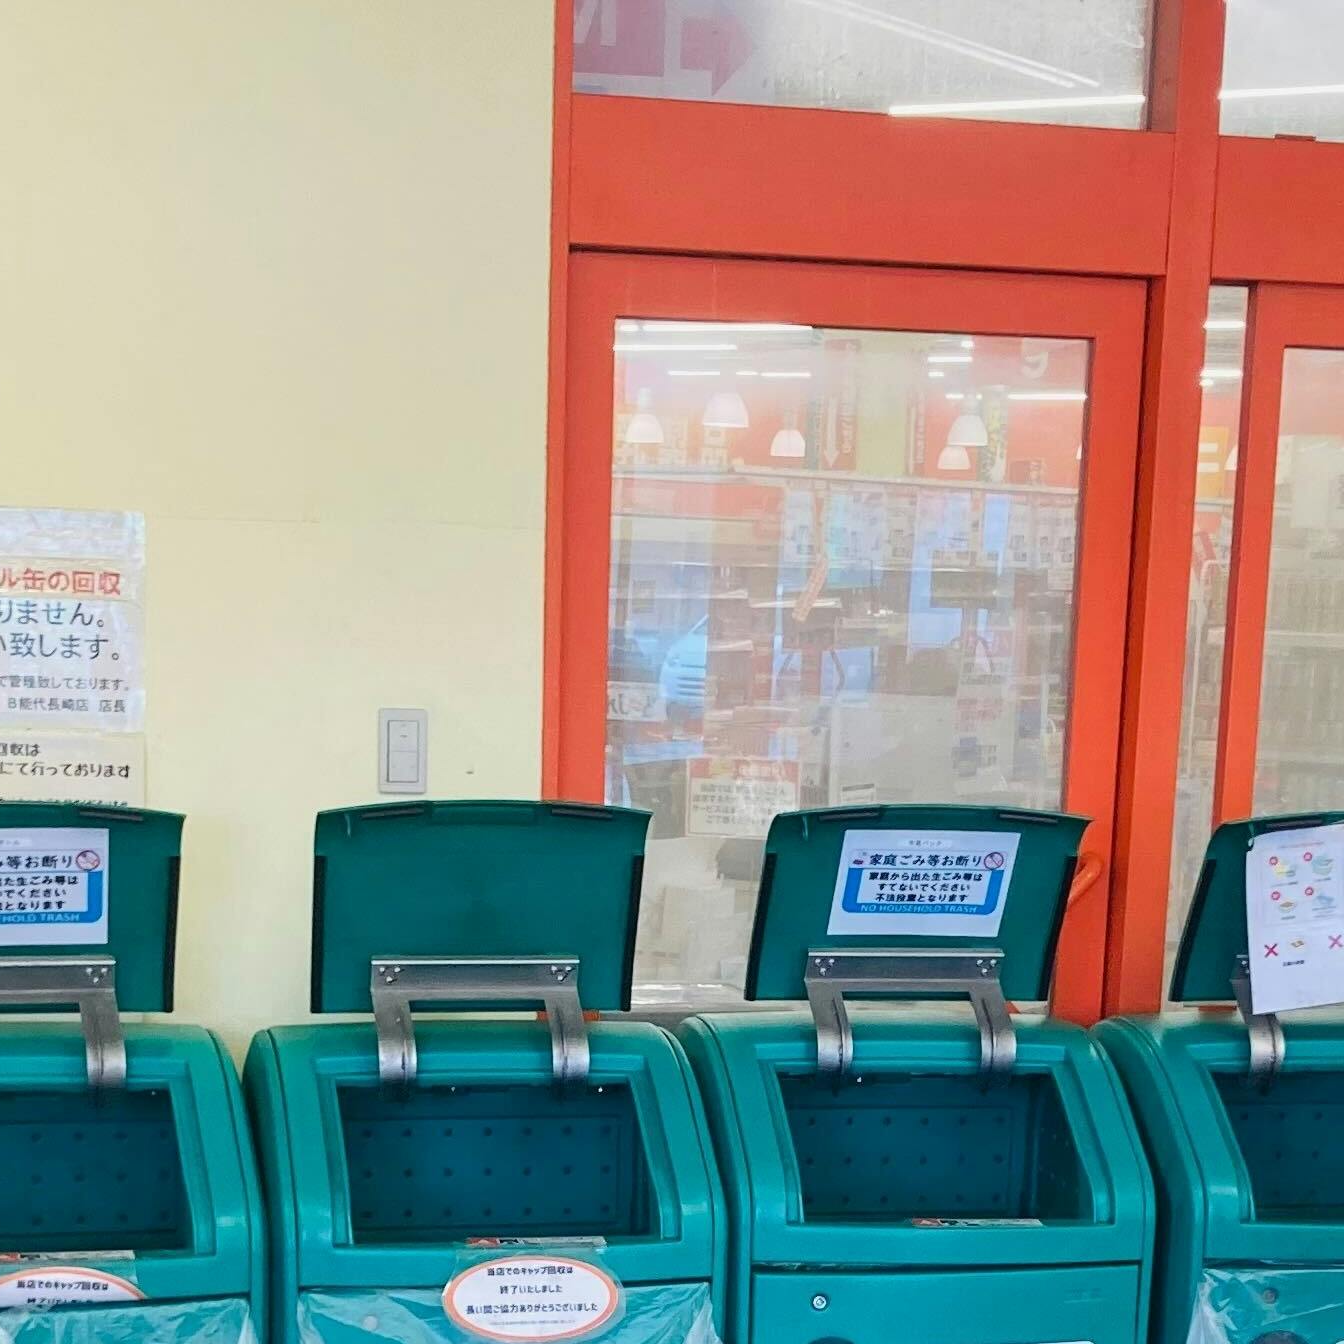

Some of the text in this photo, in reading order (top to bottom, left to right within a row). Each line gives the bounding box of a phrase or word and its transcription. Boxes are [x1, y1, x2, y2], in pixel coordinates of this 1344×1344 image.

[98, 699, 126, 713] 店長
[869, 854, 982, 867] 家庭ごみ等お断り
[868, 872, 983, 882] 家庭から出た生ごみ等は
[878, 883, 970, 892] すてないでください
[860, 904, 977, 913] NO HOUSEHOLD TRASH
[40, 913, 80, 922] TRASH
[487, 1266, 573, 1276] 当店でのキャップ回収は
